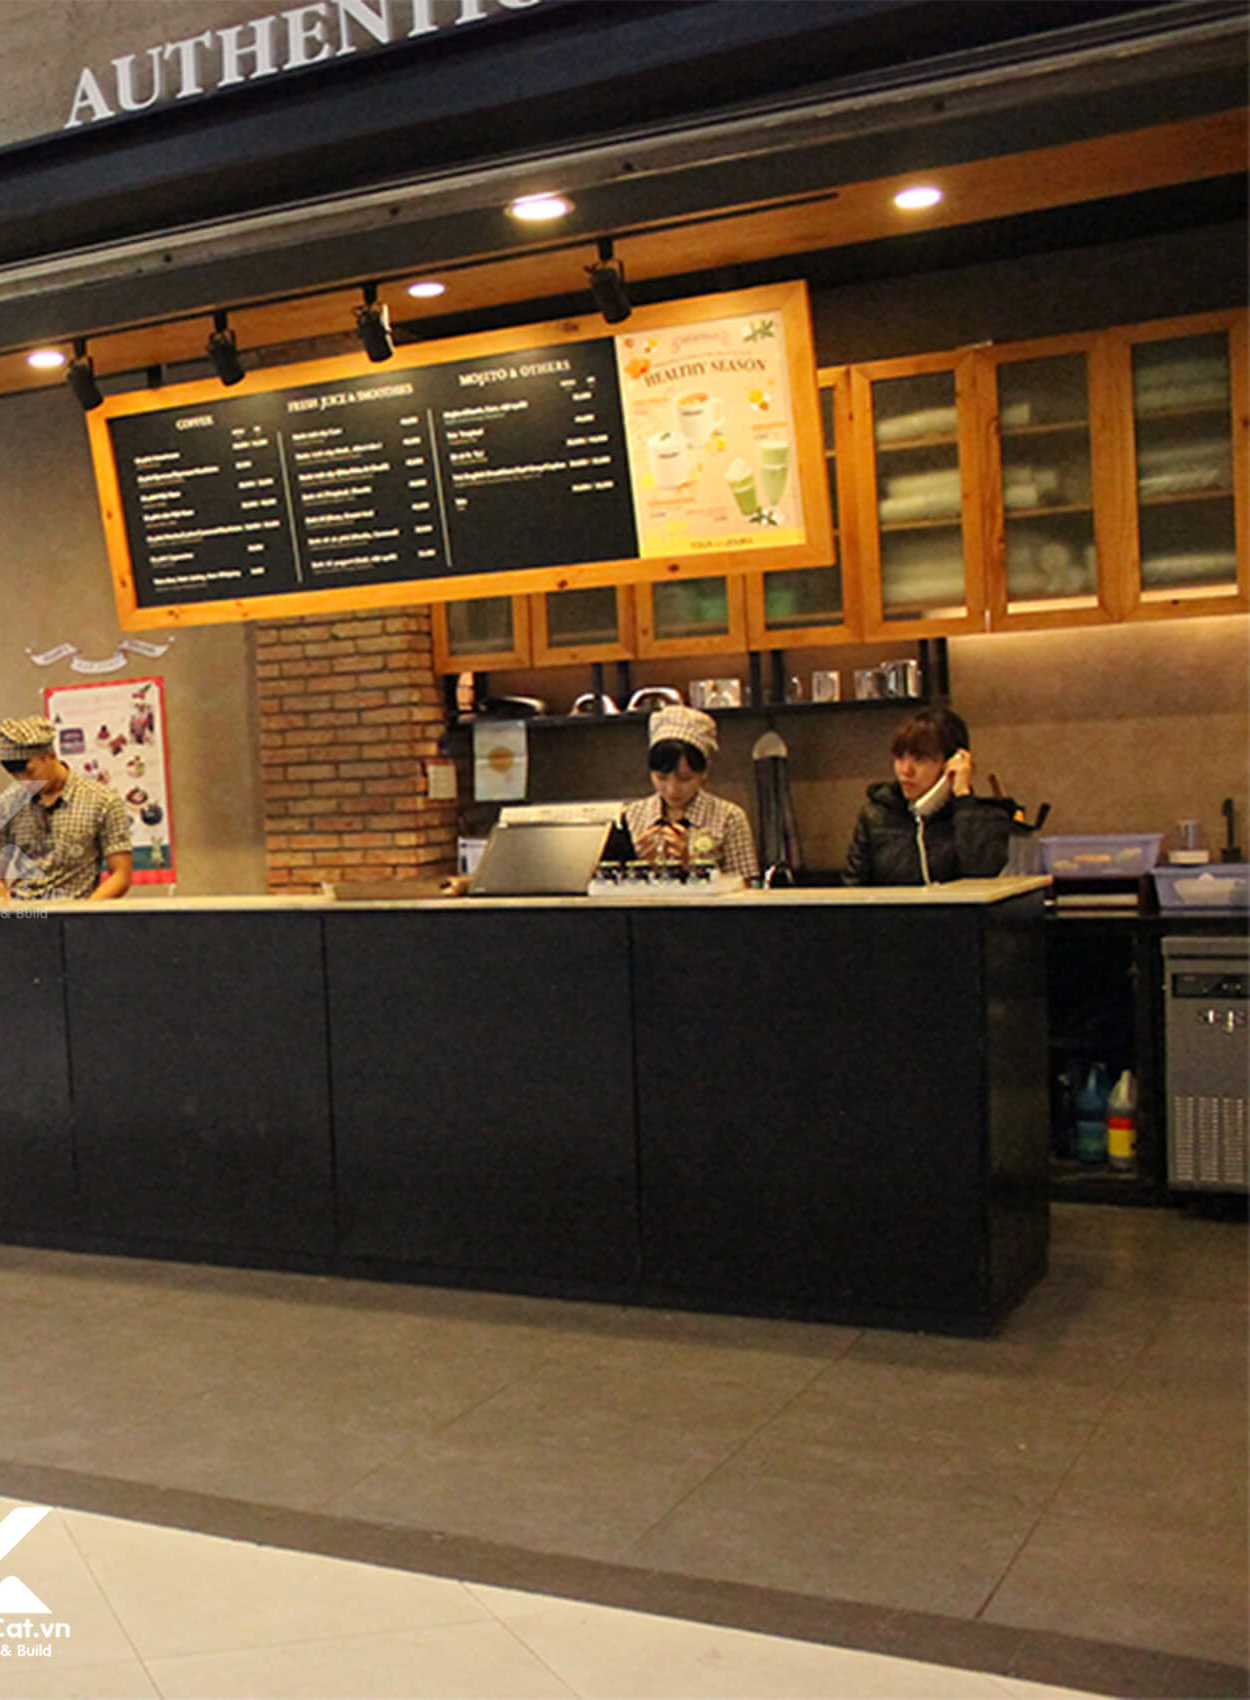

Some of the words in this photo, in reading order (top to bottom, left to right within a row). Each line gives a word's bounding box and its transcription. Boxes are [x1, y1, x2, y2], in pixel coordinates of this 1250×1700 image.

[458, 368, 507, 387] MOJITO
[519, 359, 571, 376] OTHERS
[644, 363, 705, 387] HEALTHY
[710, 358, 766, 373] SEASON
